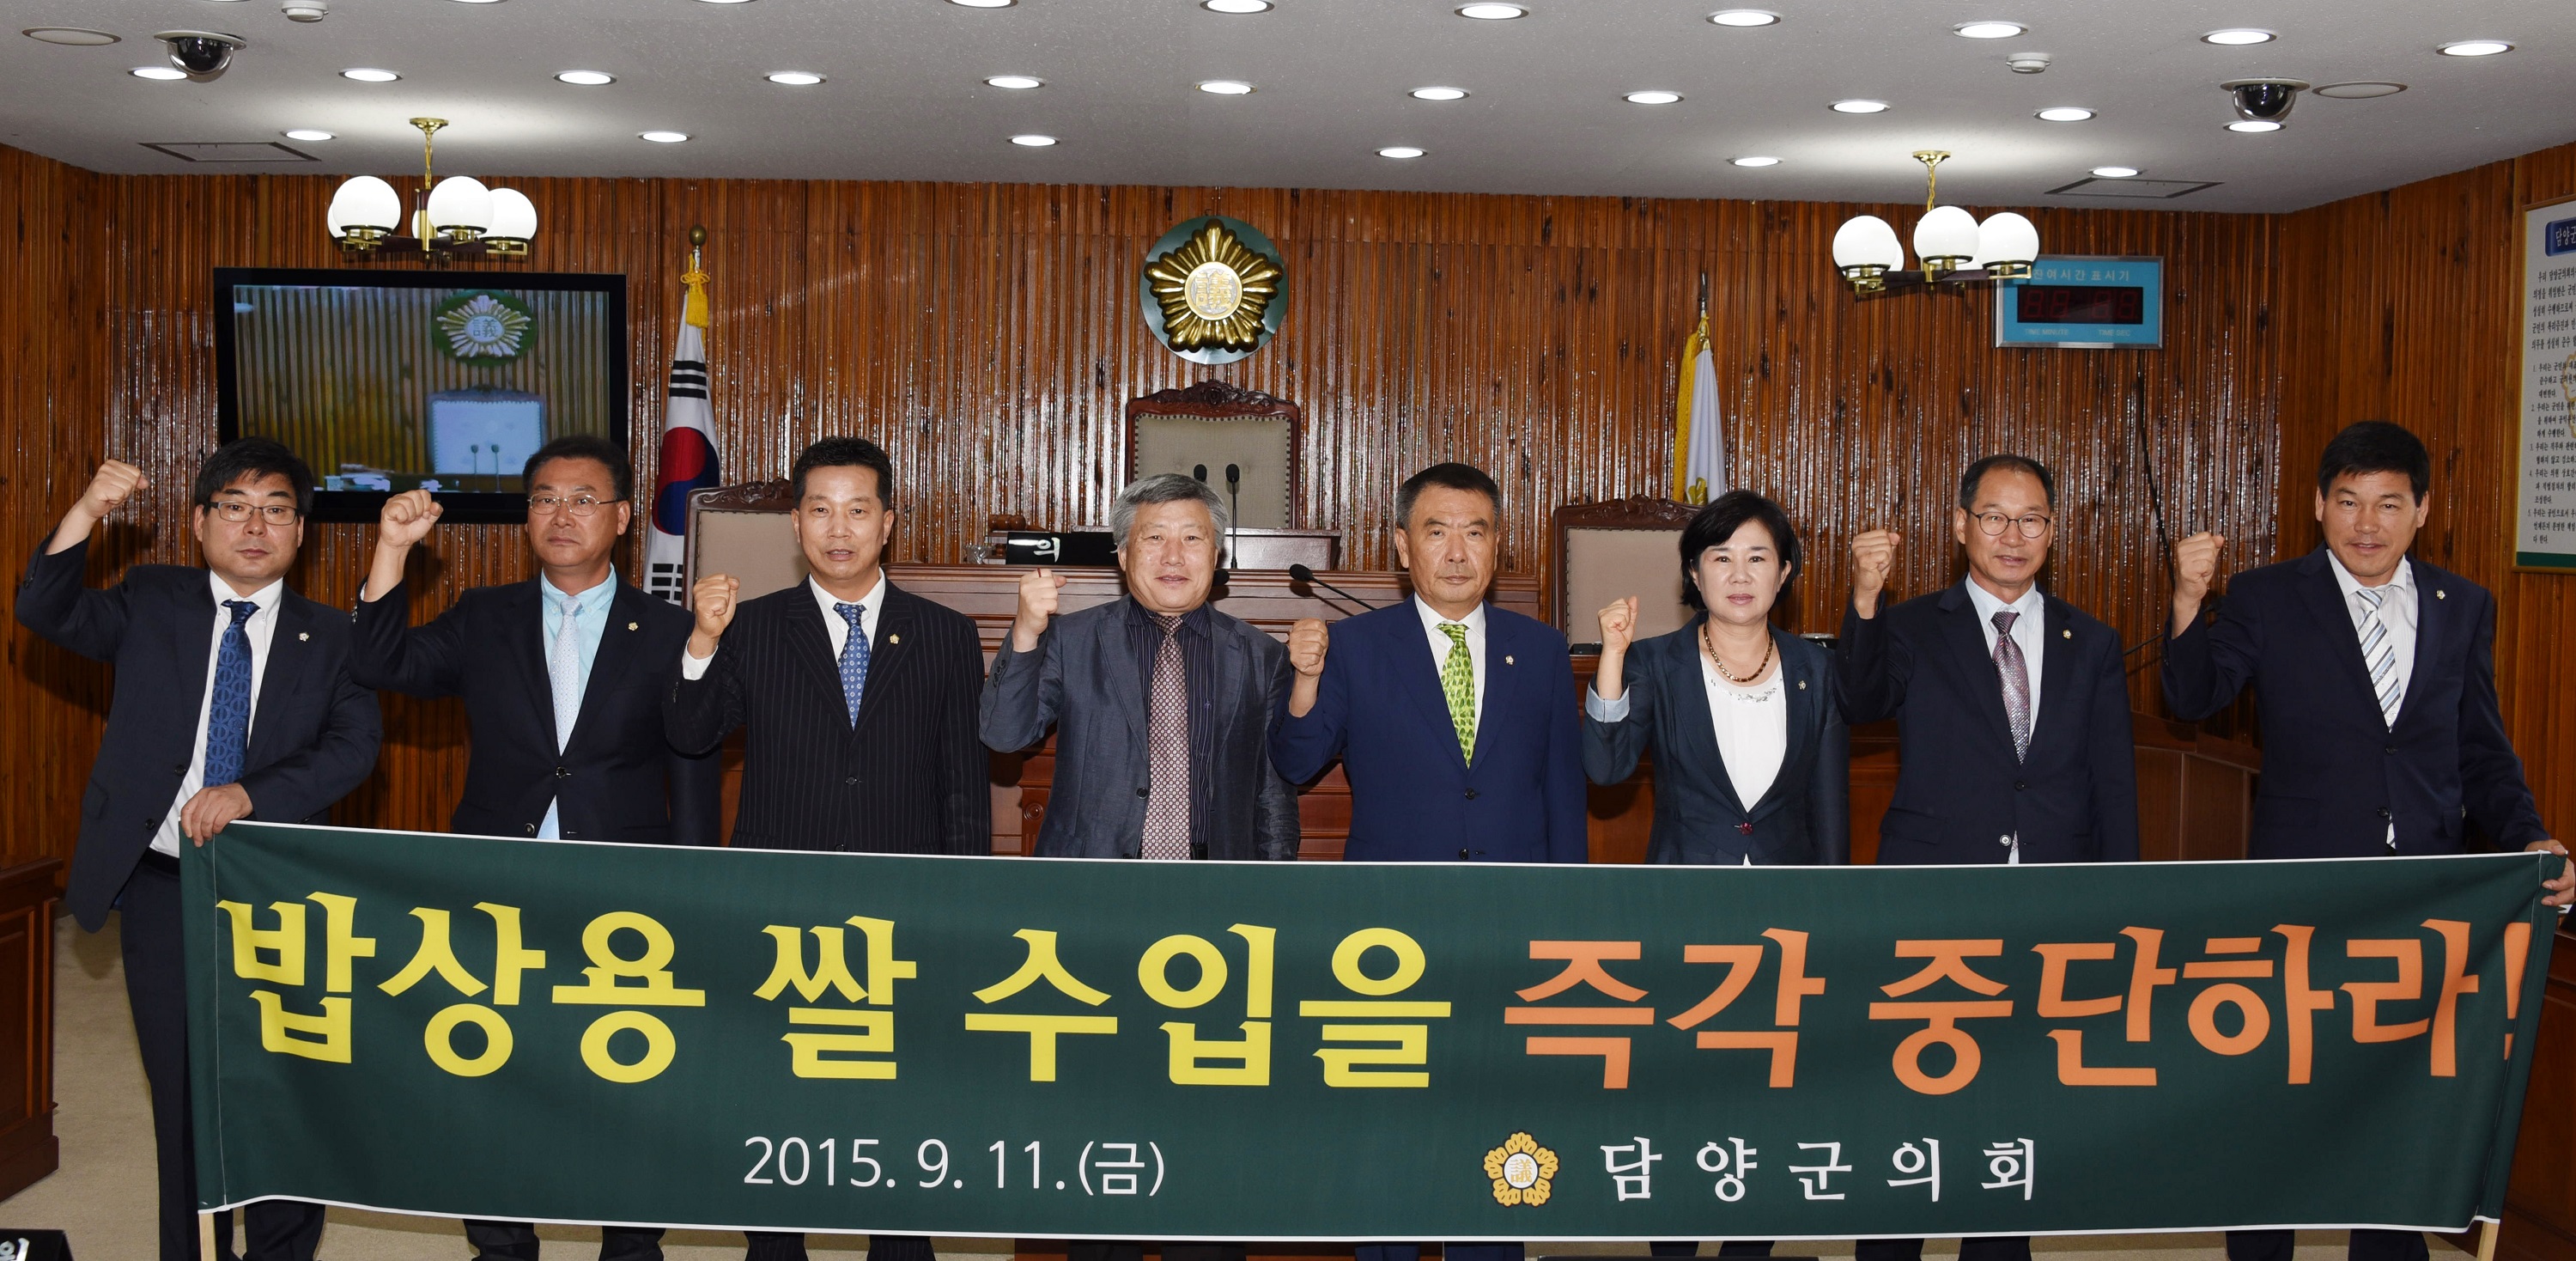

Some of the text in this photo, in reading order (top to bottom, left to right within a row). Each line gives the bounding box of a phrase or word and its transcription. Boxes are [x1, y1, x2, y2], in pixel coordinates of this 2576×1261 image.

[2549, 265, 2576, 281] 담양군의회의
[216, 892, 2530, 1095] 밥상용 쌀 수입을 즉각 중단하라!
[744, 1136, 896, 1188] 2015.
[917, 1138, 963, 1189] 9.
